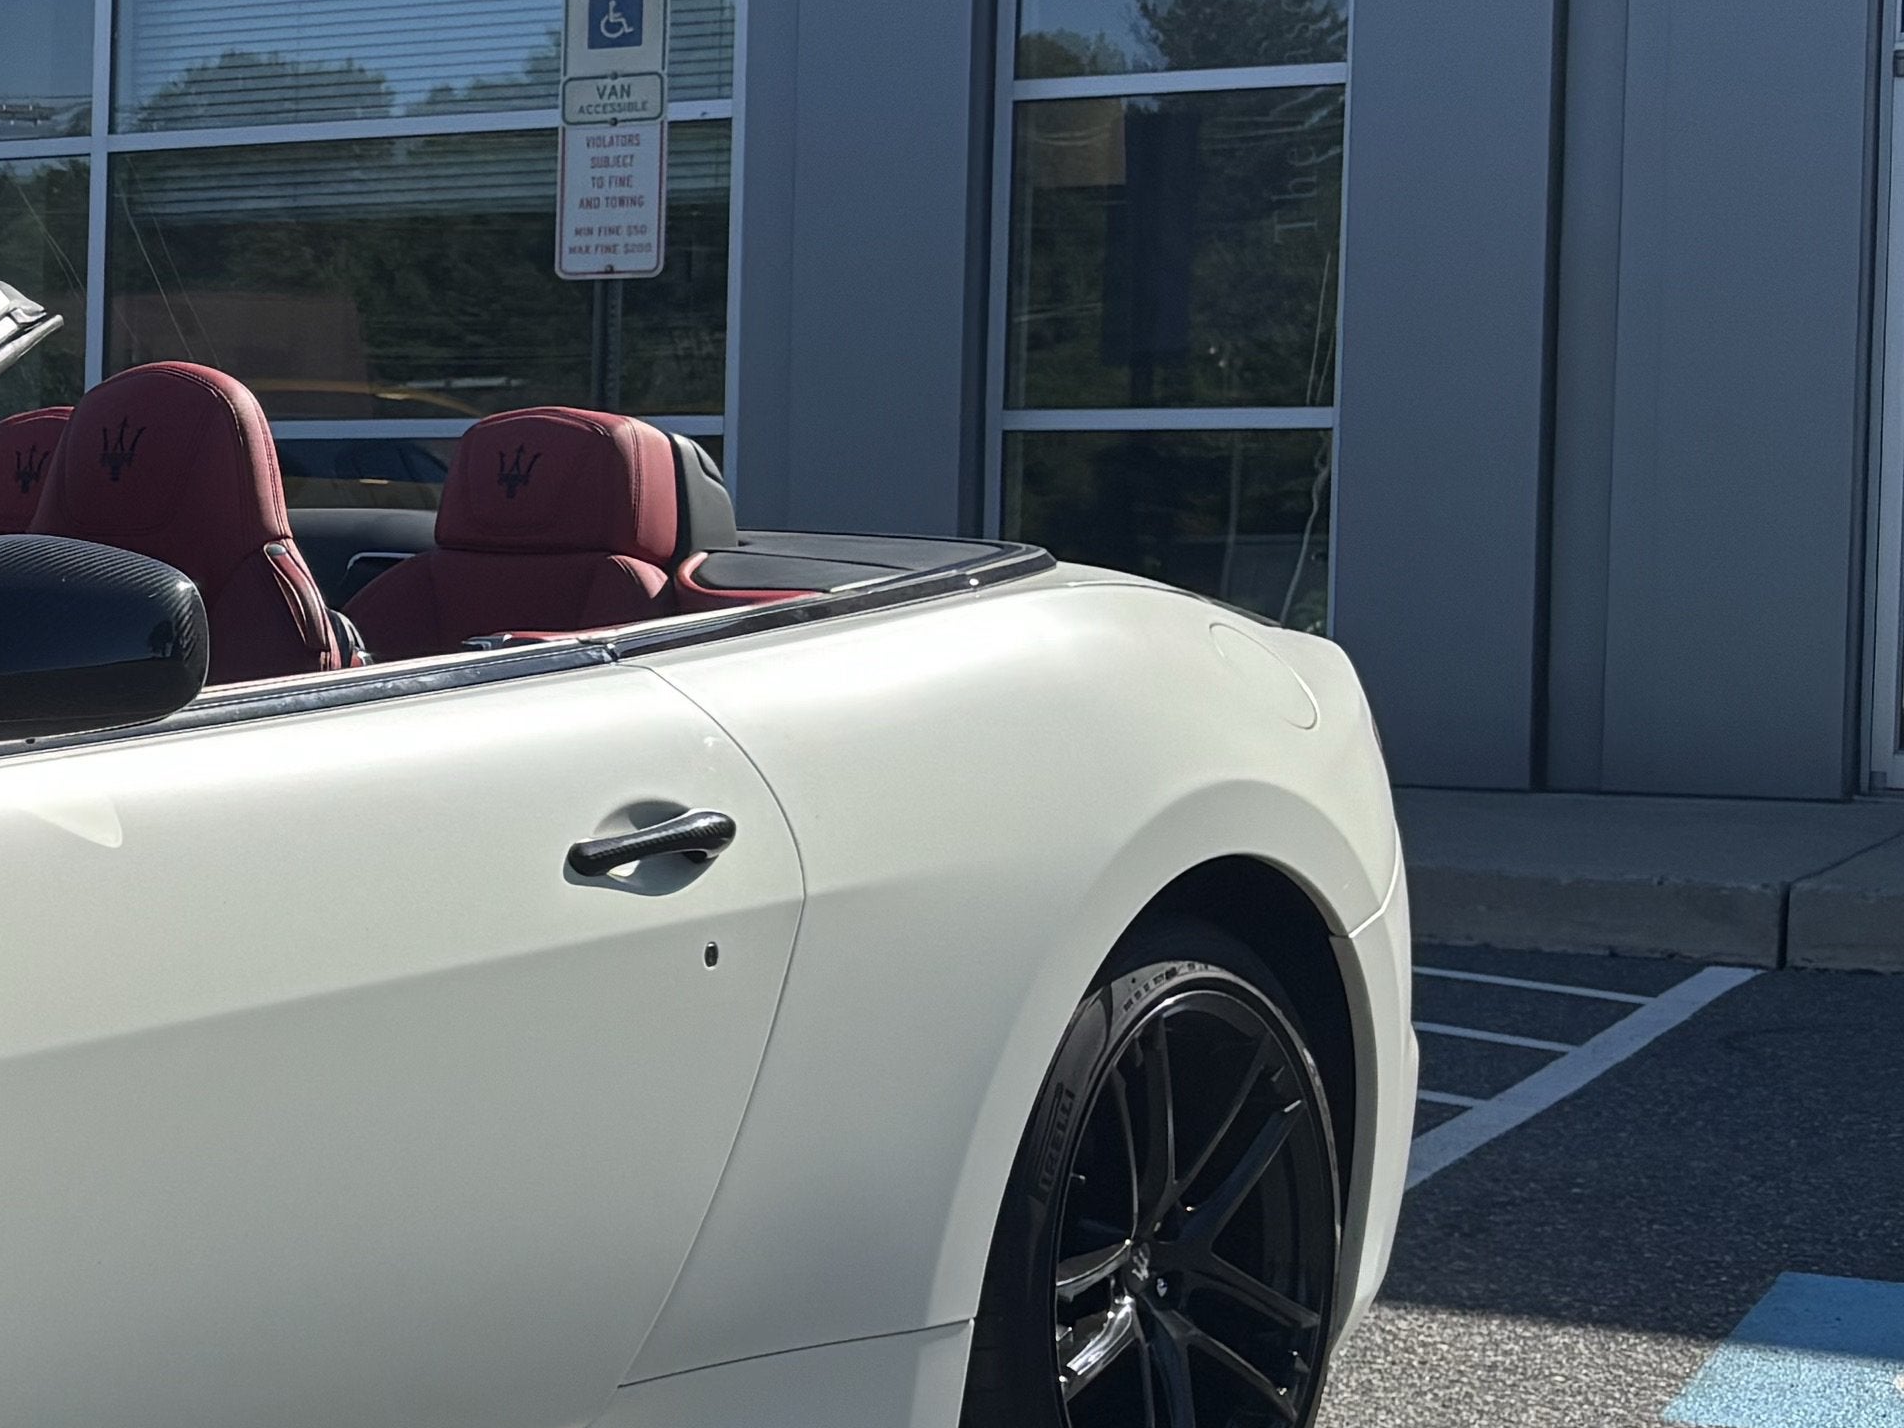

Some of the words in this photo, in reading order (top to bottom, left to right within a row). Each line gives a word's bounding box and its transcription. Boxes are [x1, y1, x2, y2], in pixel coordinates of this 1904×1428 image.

[596, 83, 631, 101] VAN
[577, 100, 648, 115] ACCESSIBLE
[585, 134, 641, 149] VIOLATORS
[590, 154, 634, 169] SUBJECT
[591, 176, 604, 189] TO
[608, 174, 633, 189] FINE
[578, 196, 601, 210] AND
[605, 195, 645, 209] TOWING
[597, 225, 623, 237] FINE
